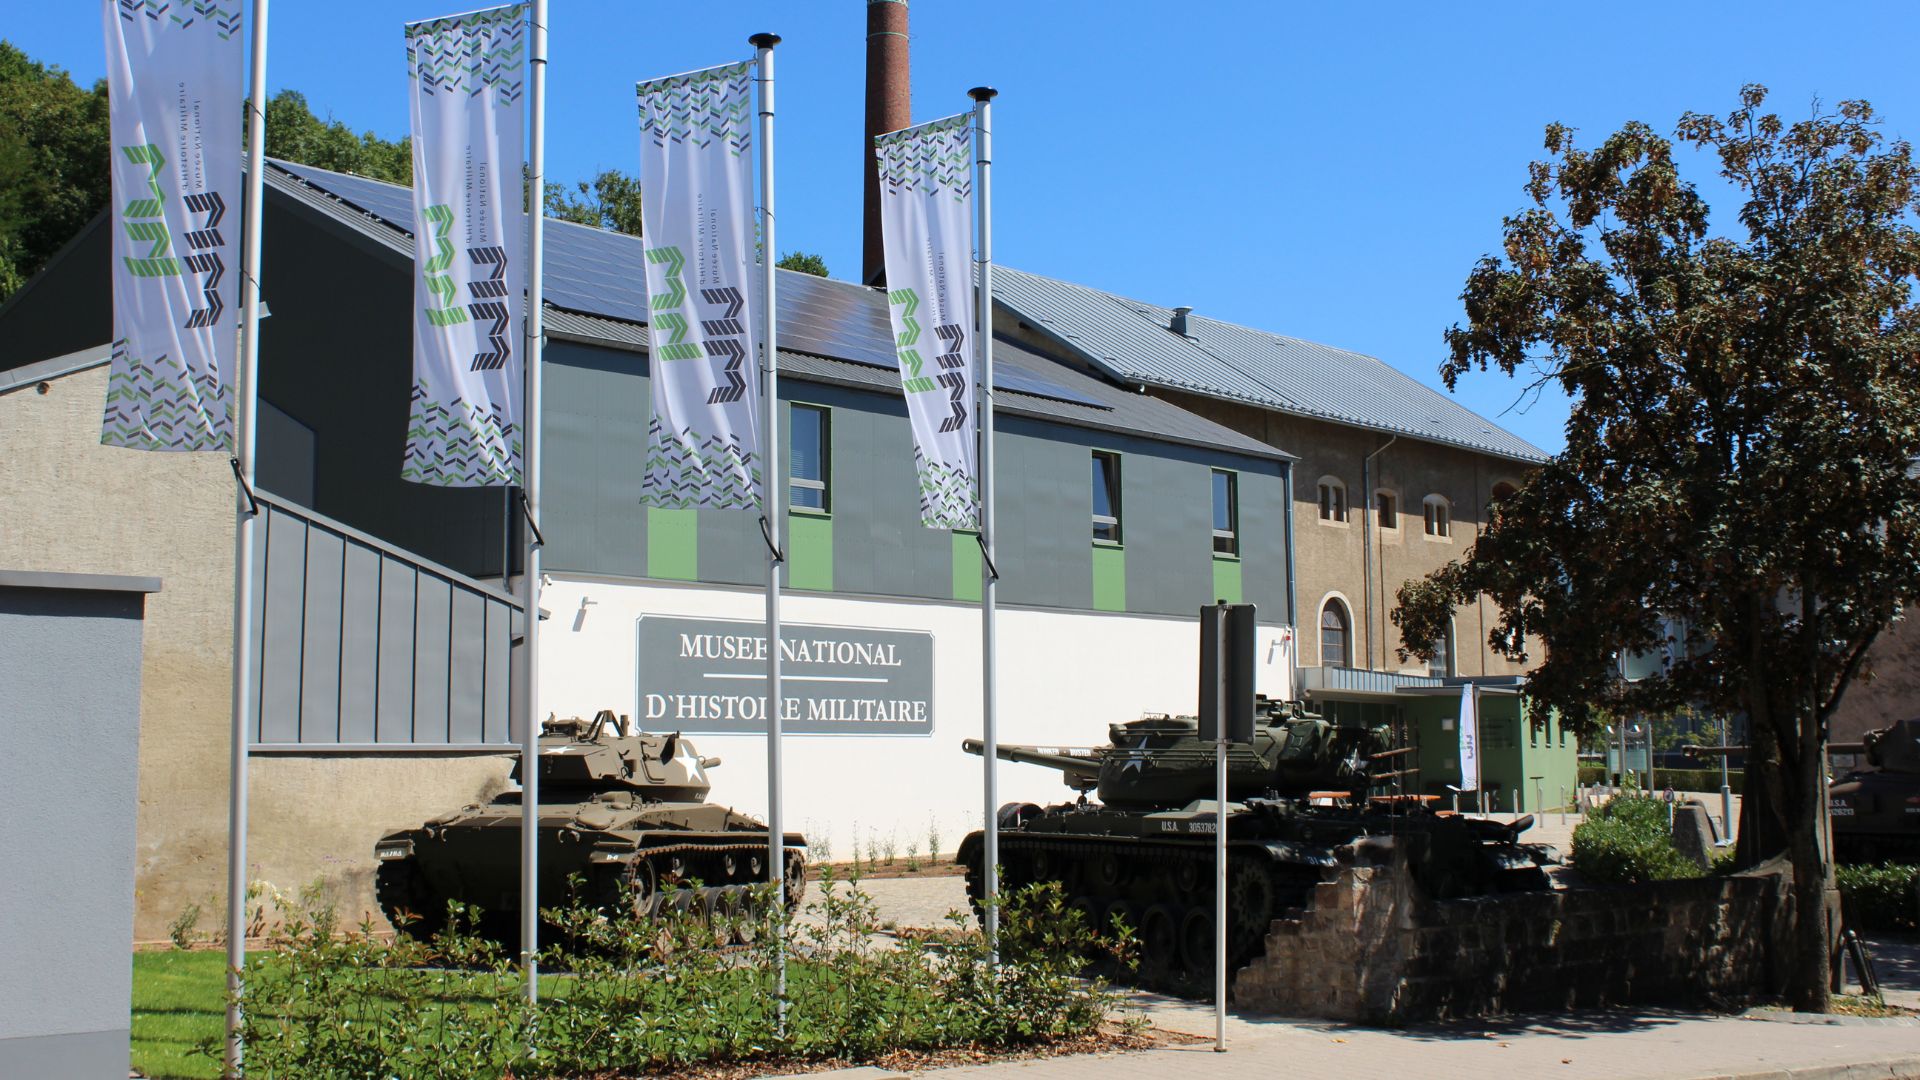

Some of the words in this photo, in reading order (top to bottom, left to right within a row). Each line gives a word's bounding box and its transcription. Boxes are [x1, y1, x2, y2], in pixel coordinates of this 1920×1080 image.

[679, 633, 767, 660] MUSEE
[779, 638, 902, 666] NATIONAL
[807, 698, 927, 723] MILITAIRE
